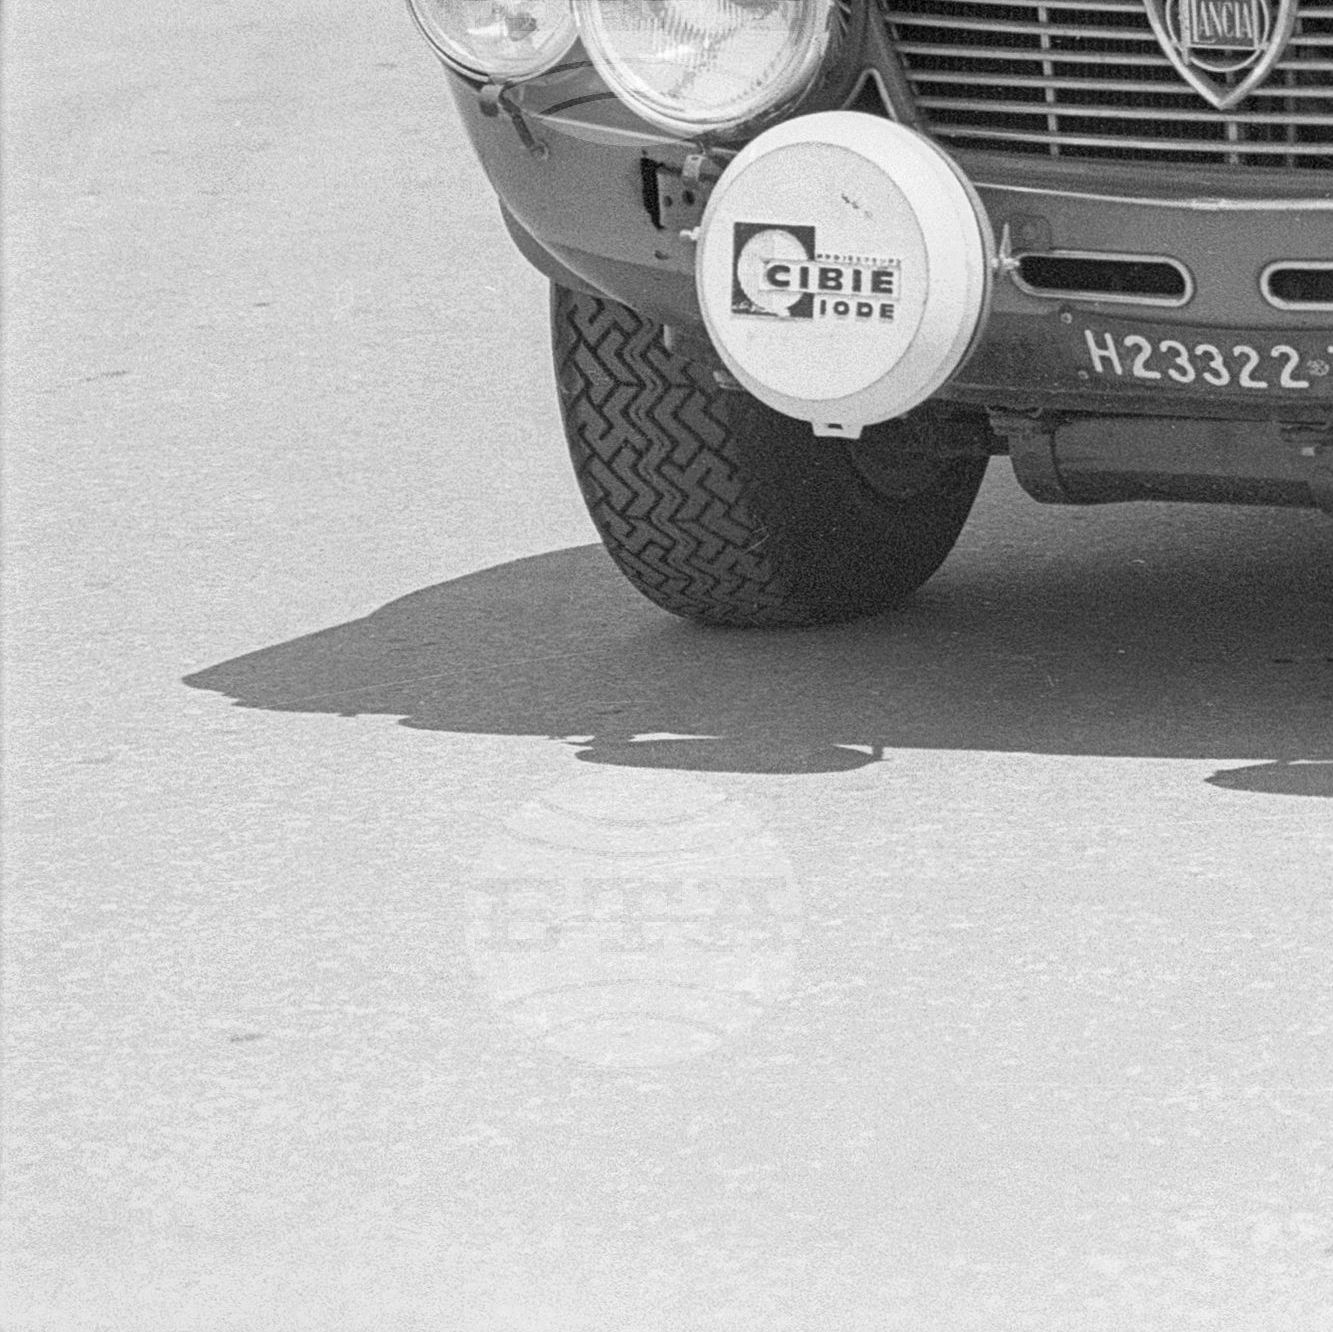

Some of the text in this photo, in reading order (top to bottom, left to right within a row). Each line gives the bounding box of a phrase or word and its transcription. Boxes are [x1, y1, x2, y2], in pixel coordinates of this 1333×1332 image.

[766, 264, 895, 294] CIBIE
[819, 299, 895, 319] IODE
[1084, 329, 1310, 389] H23322
